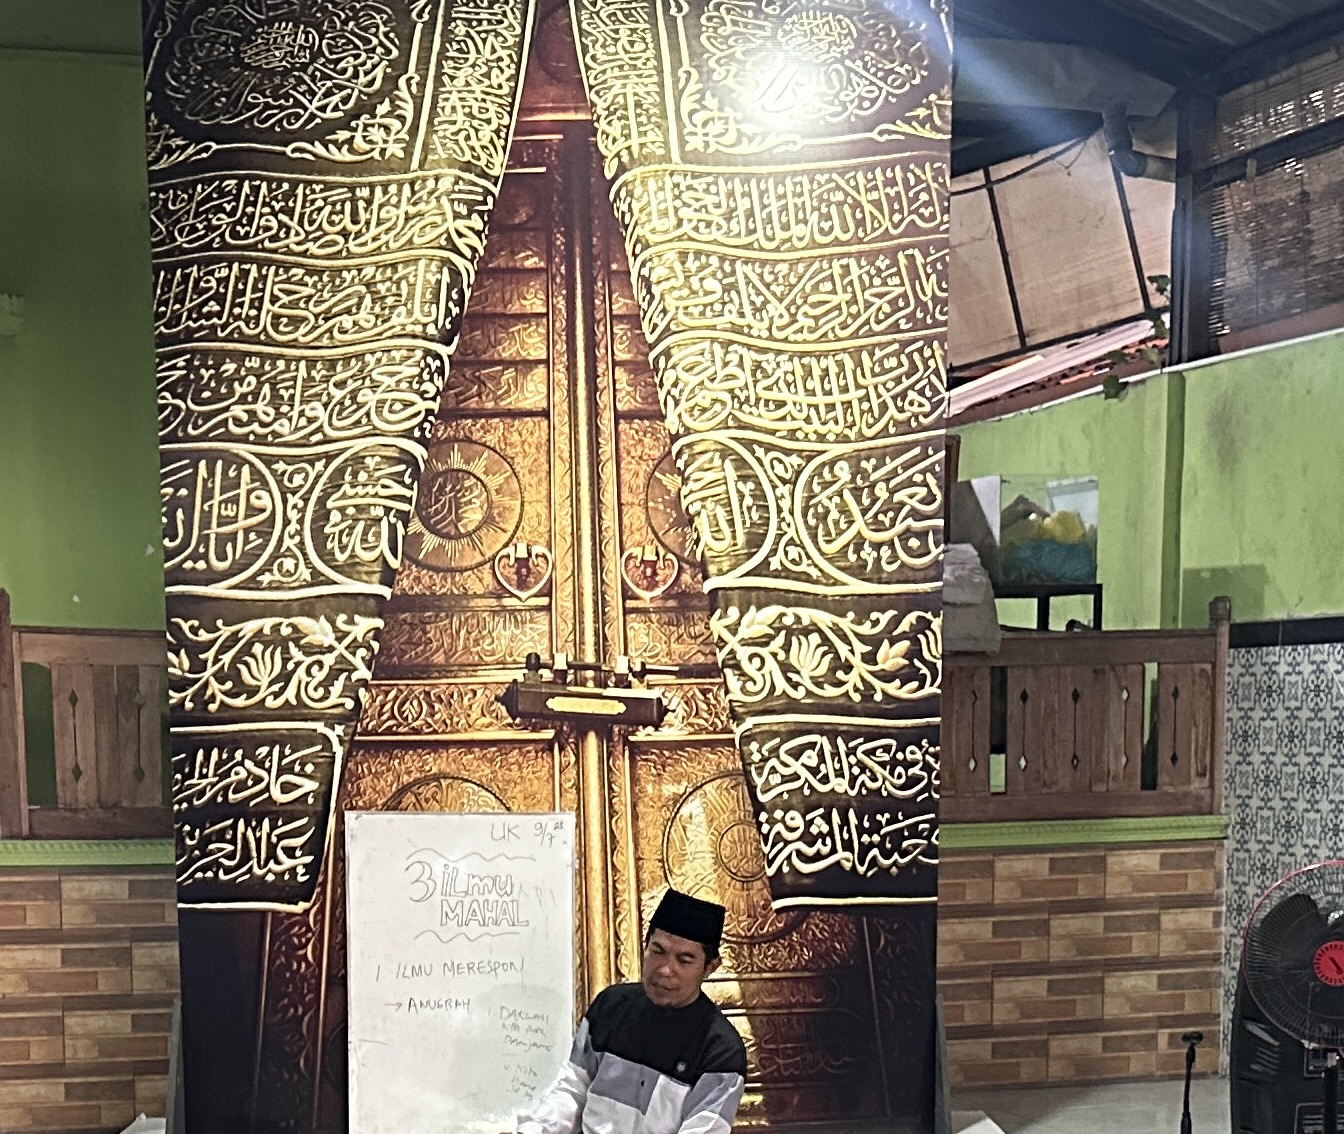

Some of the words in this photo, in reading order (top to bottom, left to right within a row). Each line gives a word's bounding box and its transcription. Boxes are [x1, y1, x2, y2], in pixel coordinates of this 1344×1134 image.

[490, 821, 521, 841] UK
[440, 899, 530, 927] MAHAL
[395, 961, 433, 980] ILMU
